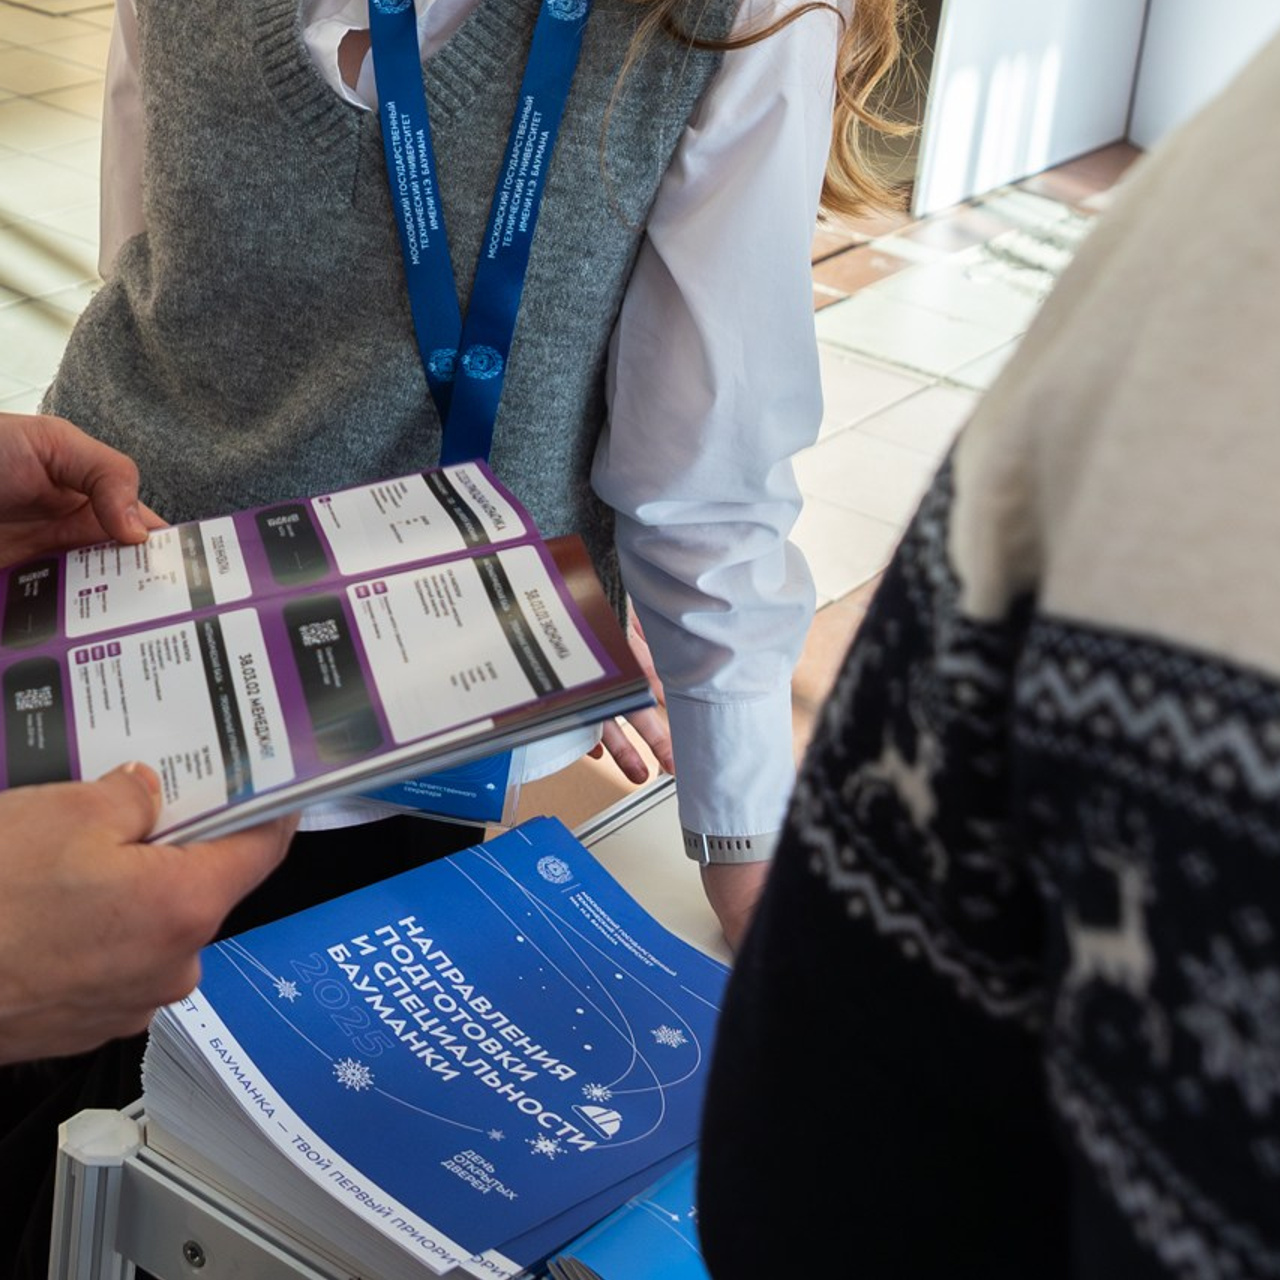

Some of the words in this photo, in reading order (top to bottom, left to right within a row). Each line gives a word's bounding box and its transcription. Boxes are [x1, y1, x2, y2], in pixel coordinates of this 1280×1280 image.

[385, 101, 408, 196] ГОСУДАРСТВЕННЫЙ
[401, 113, 418, 182] УНИВЕРСИТЕТ
[416, 129, 430, 175] БАУМАНА
[488, 192, 510, 259] МОСКОВСКИЙ
[504, 95, 535, 190] ГОСУДАРСТВЕННЫЙ
[502, 178, 525, 247] ТЕХНИЧЕСКИЙ
[518, 111, 543, 178] УНИВЕРСИТЕТ
[519, 197, 533, 233] ИМЕНИ
[531, 131, 551, 177] БАУМАНА
[400, 197, 421, 265] МОСКОВСКИЙ
[410, 181, 430, 250] ТЕХНИЧЕСКИЙ
[426, 196, 439, 231] ИМЕНИ
[576, 893, 614, 933] ТЕХНИЧЕСКИЙ
[581, 891, 620, 929] МОСКОВСКИЙ
[590, 919, 618, 946] БАУМАНА
[289, 952, 395, 1058] 2025
[326, 943, 461, 1082] БАУМАНКИ
[374, 924, 538, 1082] ПОДГОТОВКИ
[398, 915, 577, 1082] НАПРАВЛЕНИЯ
[351, 934, 378, 956] И
[373, 961, 598, 1153] СПЕЦИАЛЬНОСТИ
[209, 1037, 276, 1120] БАУМАНКА
[291, 1134, 334, 1171] ТВОЙ
[328, 1170, 394, 1219] ПЕРВЫЙ
[461, 1149, 495, 1173] ДЕНЬ
[440, 1159, 492, 1195] ДВЕРЕЙ
[453, 1154, 518, 1200] ОТКРЫТЫХ
